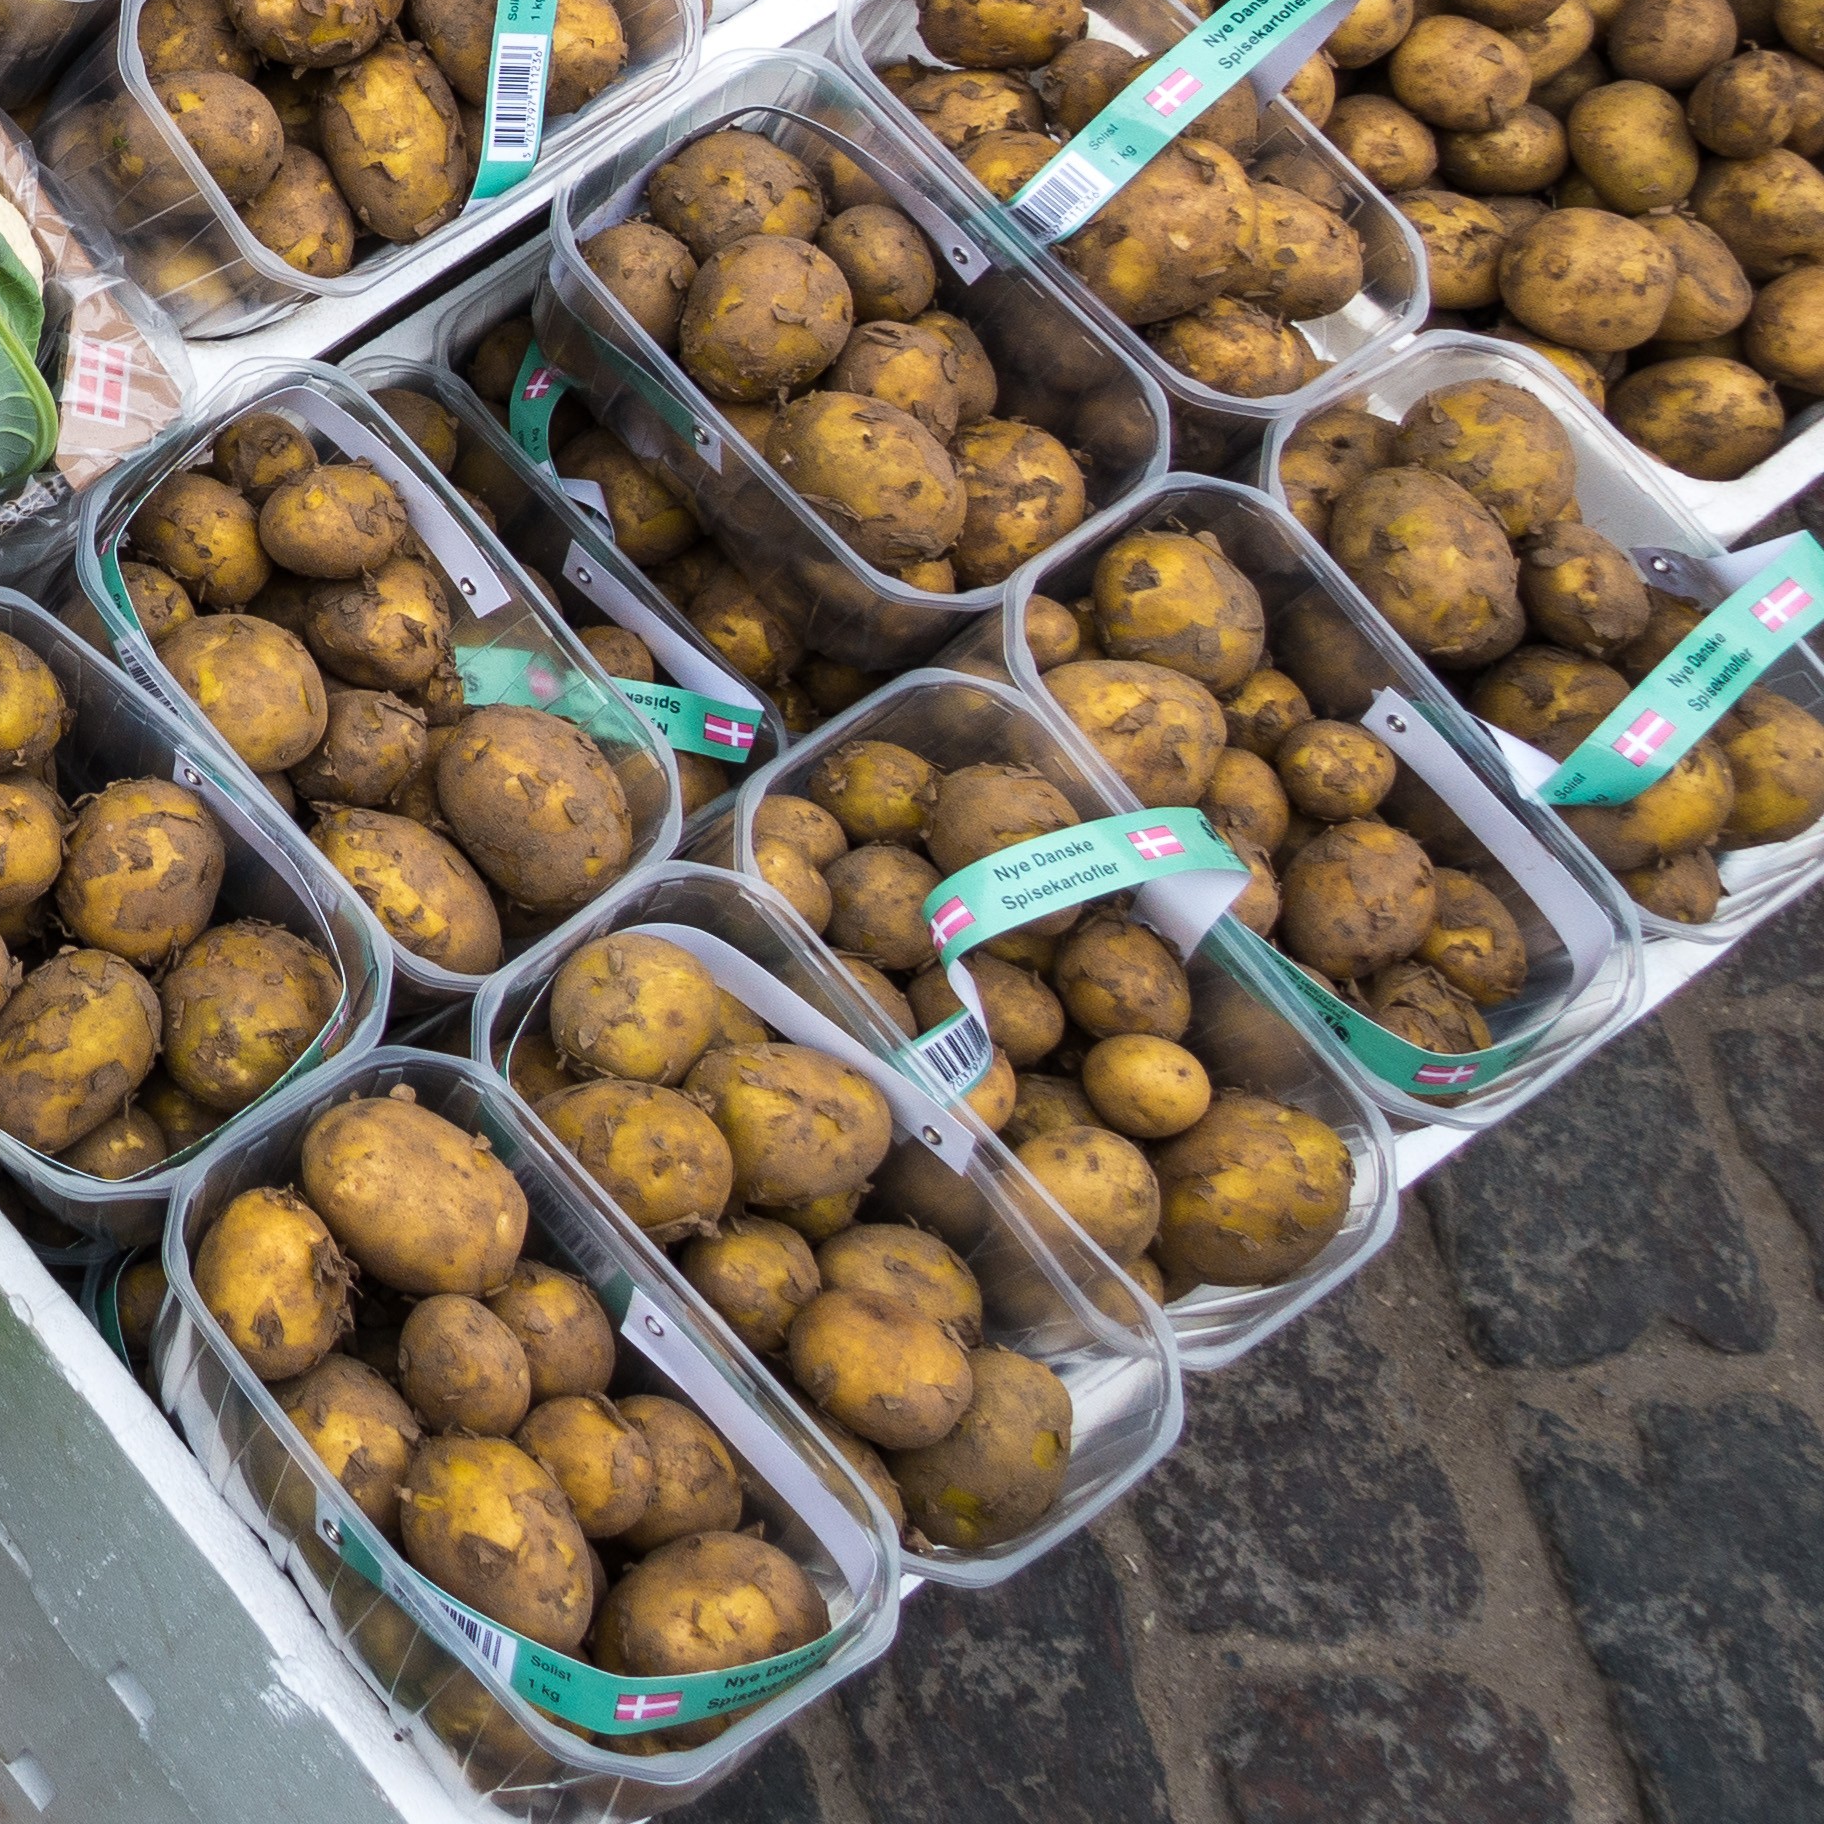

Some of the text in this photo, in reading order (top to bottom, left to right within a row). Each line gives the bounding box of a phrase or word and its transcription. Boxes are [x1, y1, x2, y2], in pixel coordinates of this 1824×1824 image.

[531, 13, 540, 21] 1
[1202, 23, 1234, 48] Nye
[1088, 123, 1119, 151] Solist
[1110, 144, 1138, 166] 1 kg
[1667, 632, 1727, 689] Nye Danske
[1687, 647, 1755, 713] Spisekartofler
[1554, 771, 1587, 801] Solist
[993, 839, 1096, 882] Nye Danske
[1001, 861, 1120, 911] Spisekartofler
[529, 1653, 573, 1684] Solist
[527, 1677, 563, 1705] 1 kg
